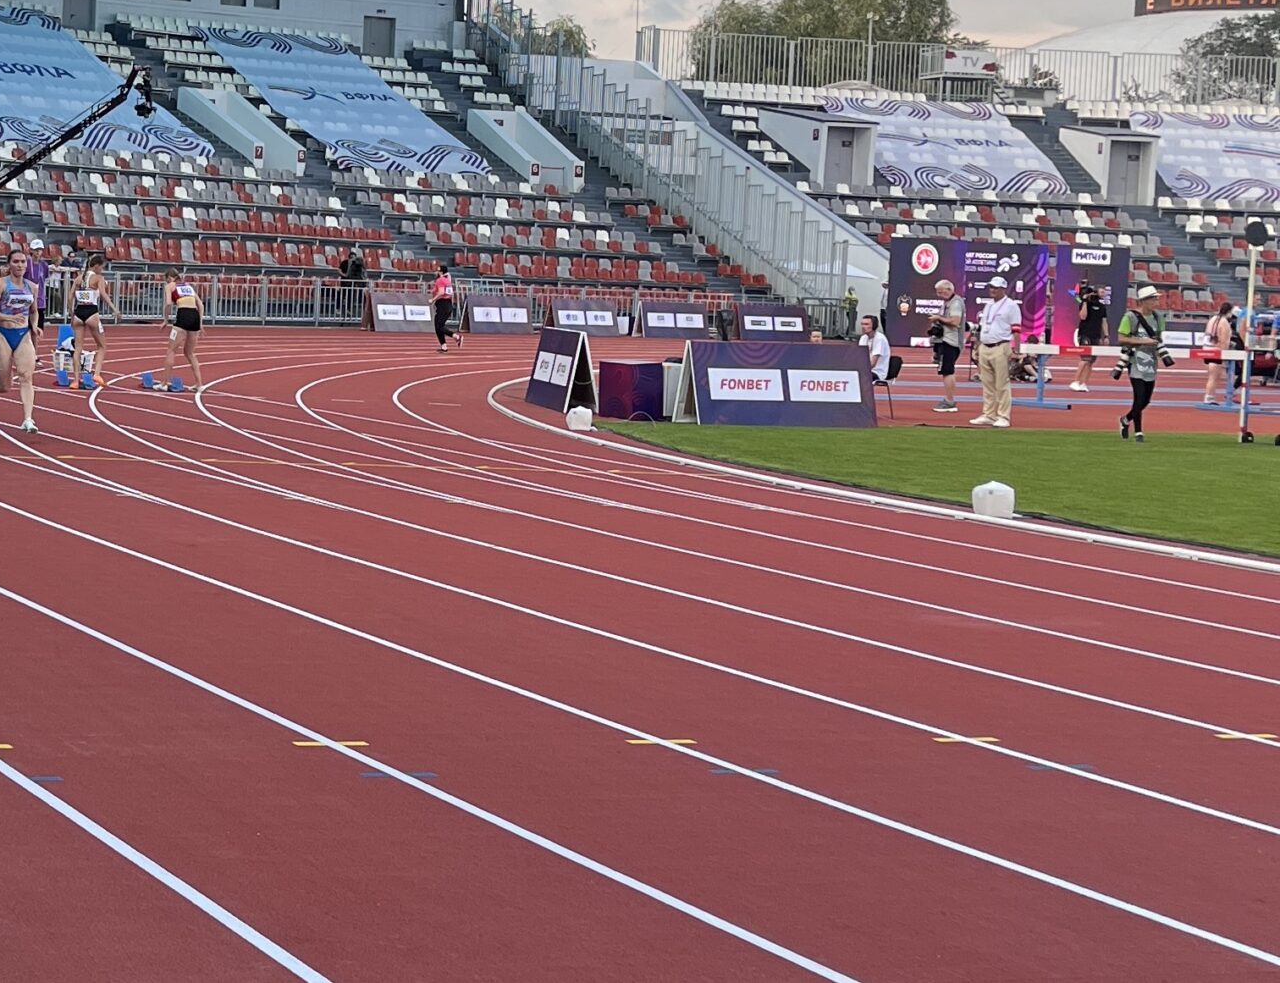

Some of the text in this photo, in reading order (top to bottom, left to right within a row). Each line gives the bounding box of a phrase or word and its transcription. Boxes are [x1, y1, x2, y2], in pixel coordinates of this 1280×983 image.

[961, 56, 980, 68] TV
[720, 378, 772, 391] FONBET
[800, 379, 849, 392] FONBET
